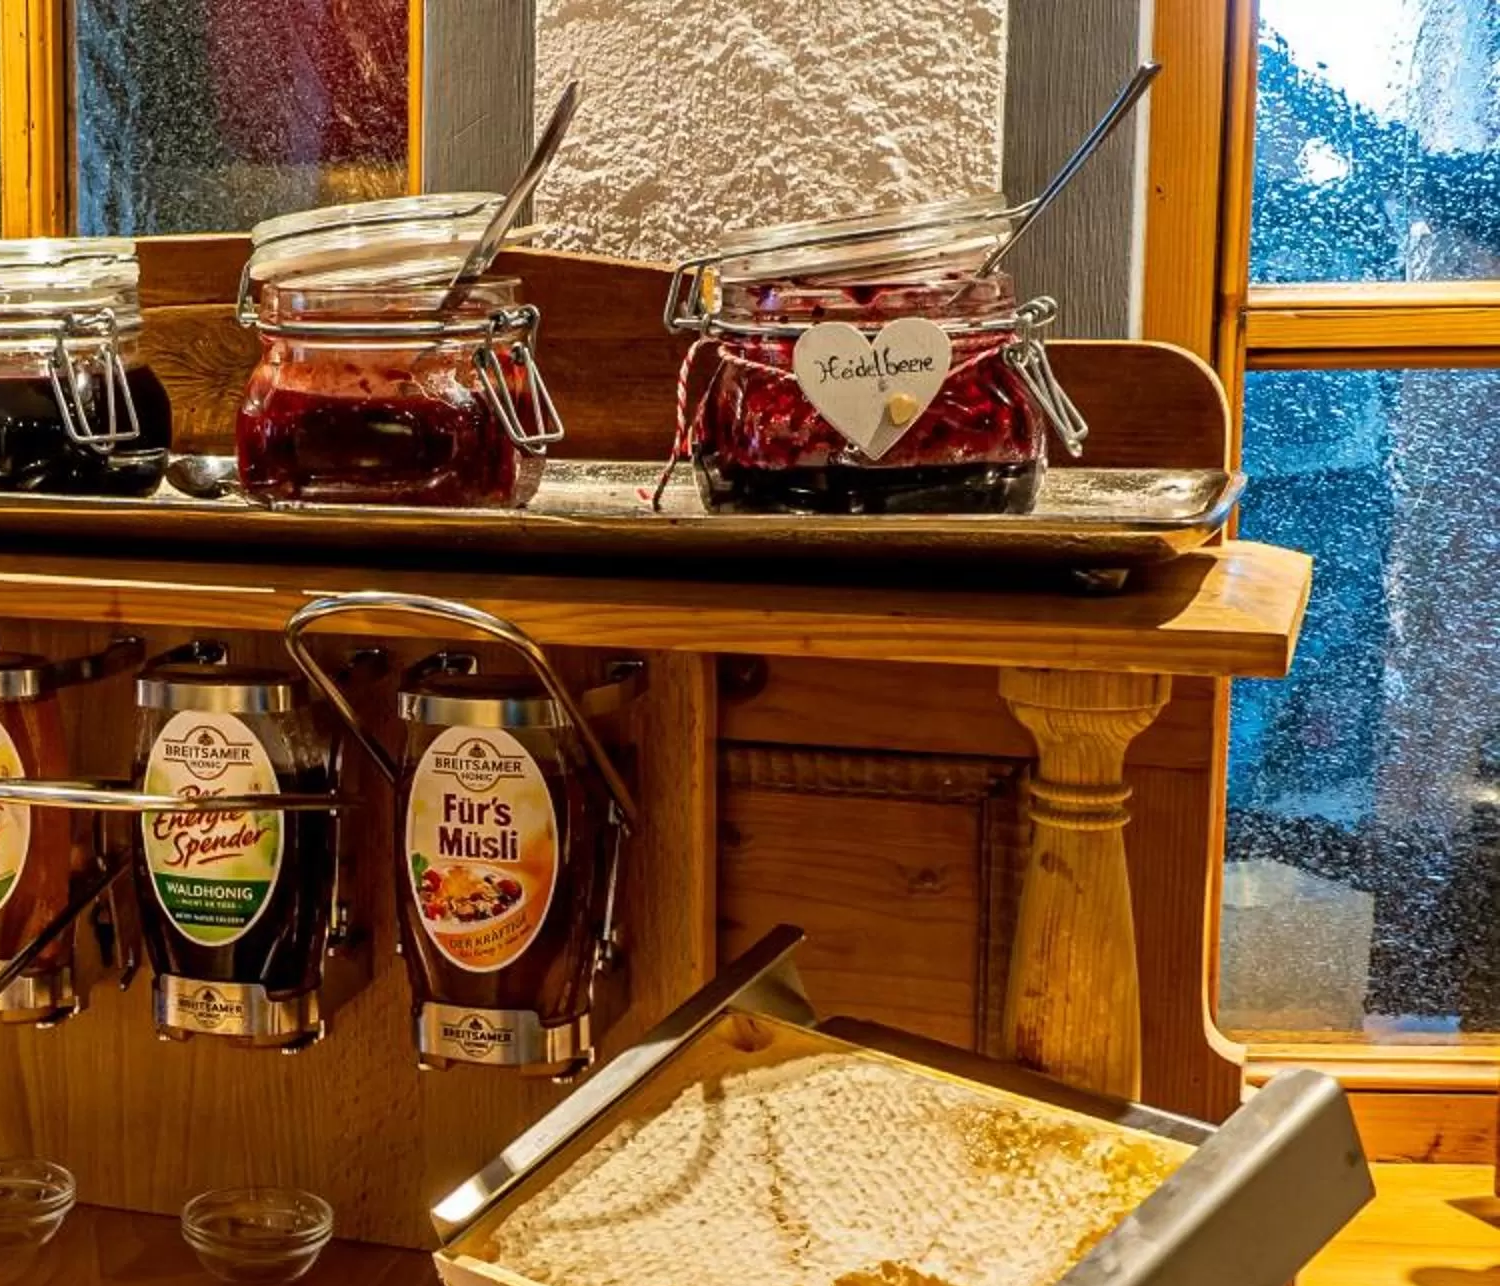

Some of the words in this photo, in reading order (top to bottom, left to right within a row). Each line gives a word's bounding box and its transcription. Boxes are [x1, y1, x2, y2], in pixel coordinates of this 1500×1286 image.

[813, 347, 936, 383] Heidelbeere
[165, 744, 251, 760] BREITSAMER
[435, 757, 522, 772] BREITSAMER
[461, 772, 493, 781] HONIG
[444, 793, 511, 826] Für's
[164, 824, 271, 869] Spender
[438, 826, 518, 860] Müsli
[166, 881, 253, 900] WALDHONIG
[443, 1027, 513, 1041] BREITSAMER
